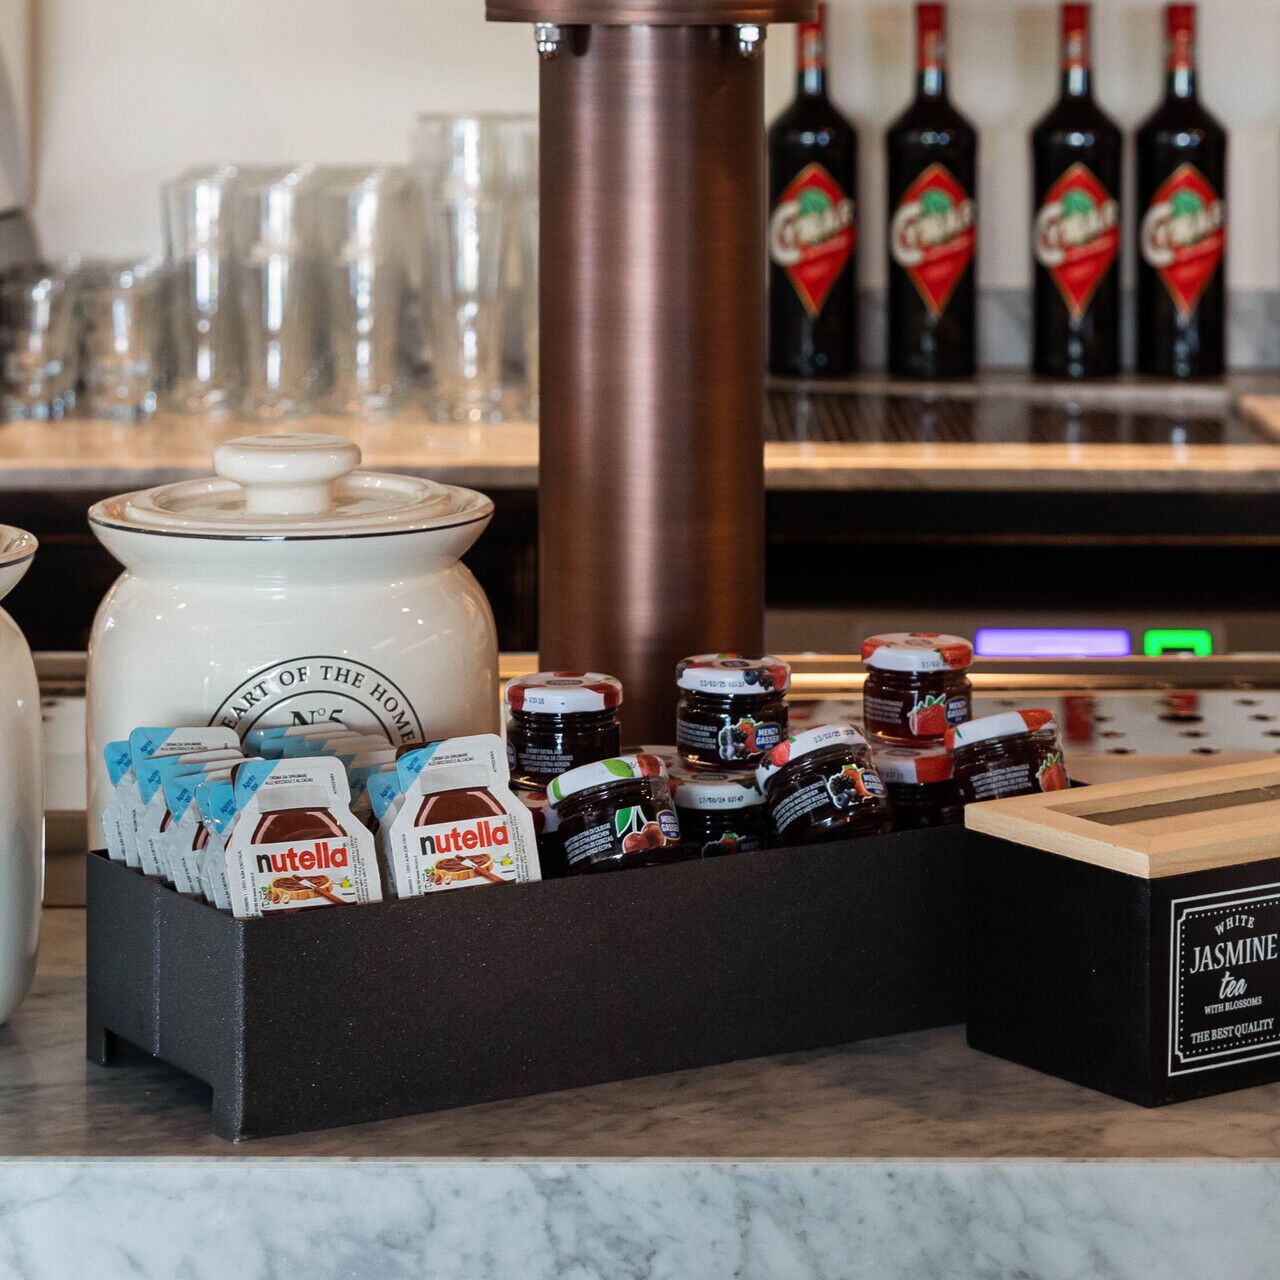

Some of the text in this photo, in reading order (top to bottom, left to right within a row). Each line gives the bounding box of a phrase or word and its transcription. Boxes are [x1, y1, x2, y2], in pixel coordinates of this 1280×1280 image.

[220, 665, 415, 744] EART OF THE HOME
[420, 820, 509, 856] nutella
[256, 841, 348, 873] nutella
[1215, 915, 1255, 935] WHITE
[1189, 933, 1278, 974] JASMINE
[1220, 971, 1247, 999] tea
[1204, 996, 1262, 1014] WITH BLOSSOMS
[1191, 1018, 1274, 1044] THE BEST QUALITY
